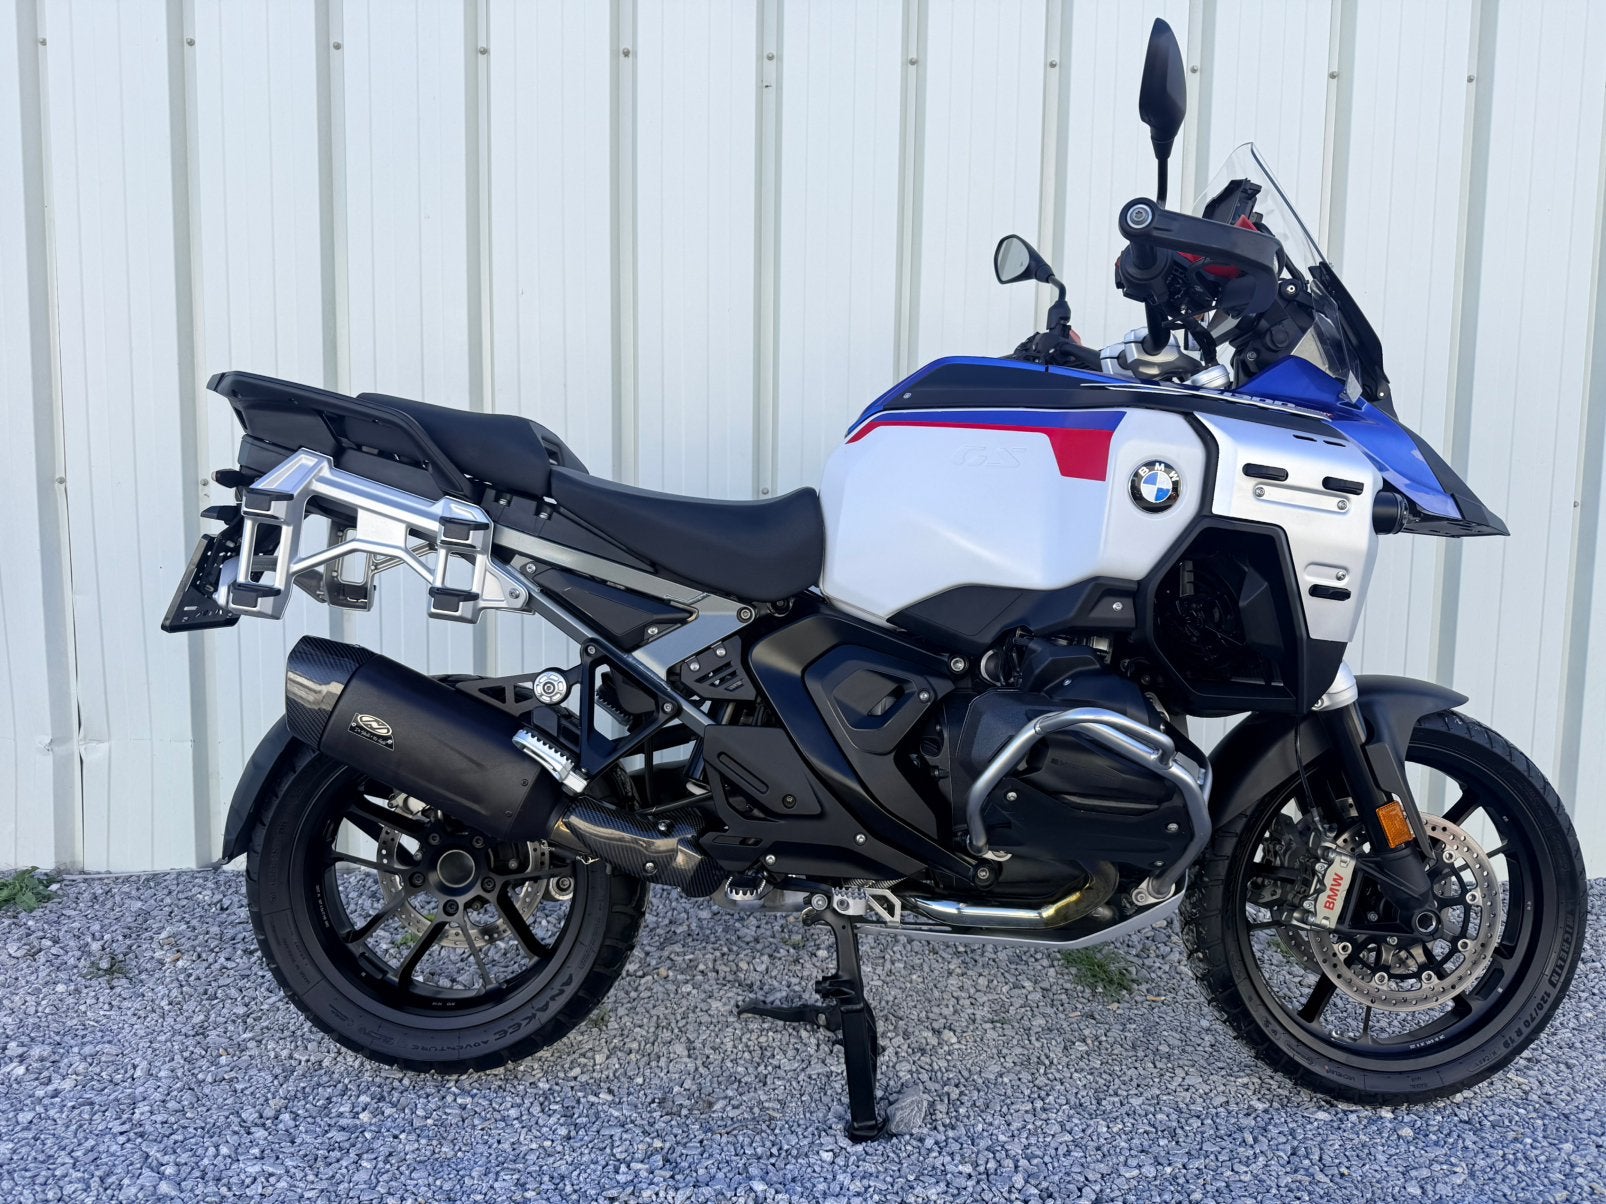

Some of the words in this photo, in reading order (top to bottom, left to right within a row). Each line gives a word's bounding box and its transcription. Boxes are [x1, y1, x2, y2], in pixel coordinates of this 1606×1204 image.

[1138, 462, 1180, 482] BMW
[1323, 872, 1344, 911] BMW
[1550, 912, 1576, 987] MICHELIN
[494, 973, 574, 1041] ANAKEE
[1523, 990, 1552, 1029] 120/70
[411, 1040, 490, 1052] ADVENTURE
[1502, 1035, 1517, 1050] 19
[1514, 1026, 1524, 1038] R
